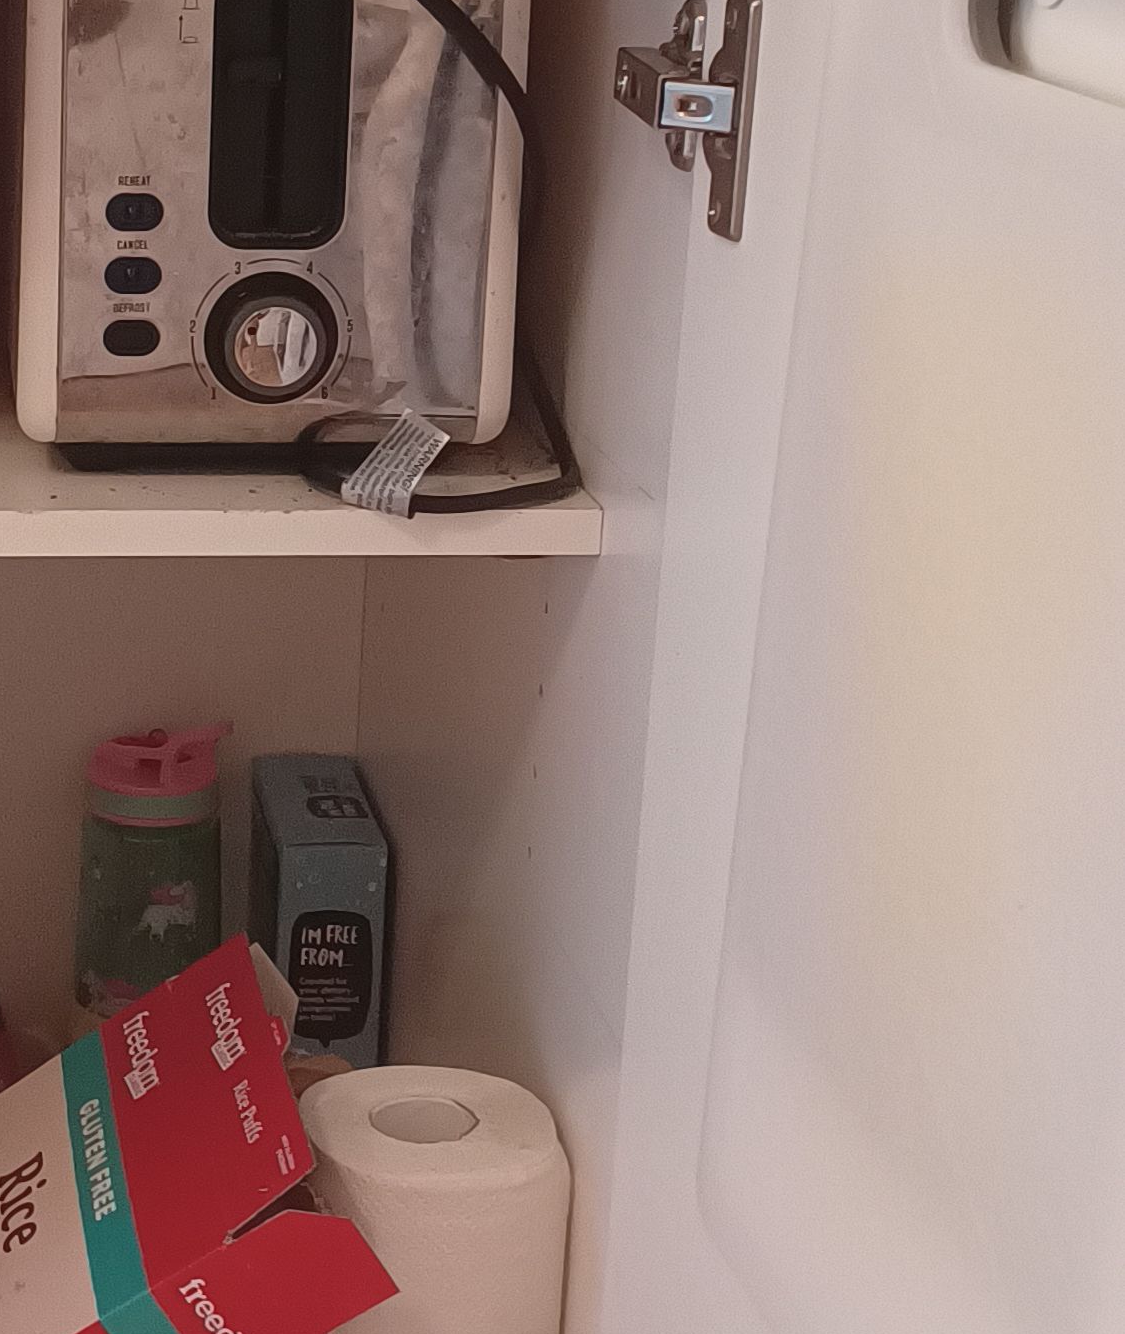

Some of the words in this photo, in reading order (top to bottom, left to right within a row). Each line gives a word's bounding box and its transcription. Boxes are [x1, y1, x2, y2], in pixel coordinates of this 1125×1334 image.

[117, 175, 151, 186] REHEAT
[116, 240, 148, 250] CANCEL
[234, 261, 242, 275] 3
[306, 261, 313, 274] 4
[189, 319, 197, 333] 2
[346, 319, 354, 333] 5
[210, 387, 217, 400] 1
[320, 386, 329, 400] 6
[326, 924, 359, 945] FREE
[206, 982, 246, 1060] freedom
[123, 1010, 160, 1091] freedom
[79, 1098, 108, 1171] GLUTEN
[89, 1166, 117, 1222] FREE
